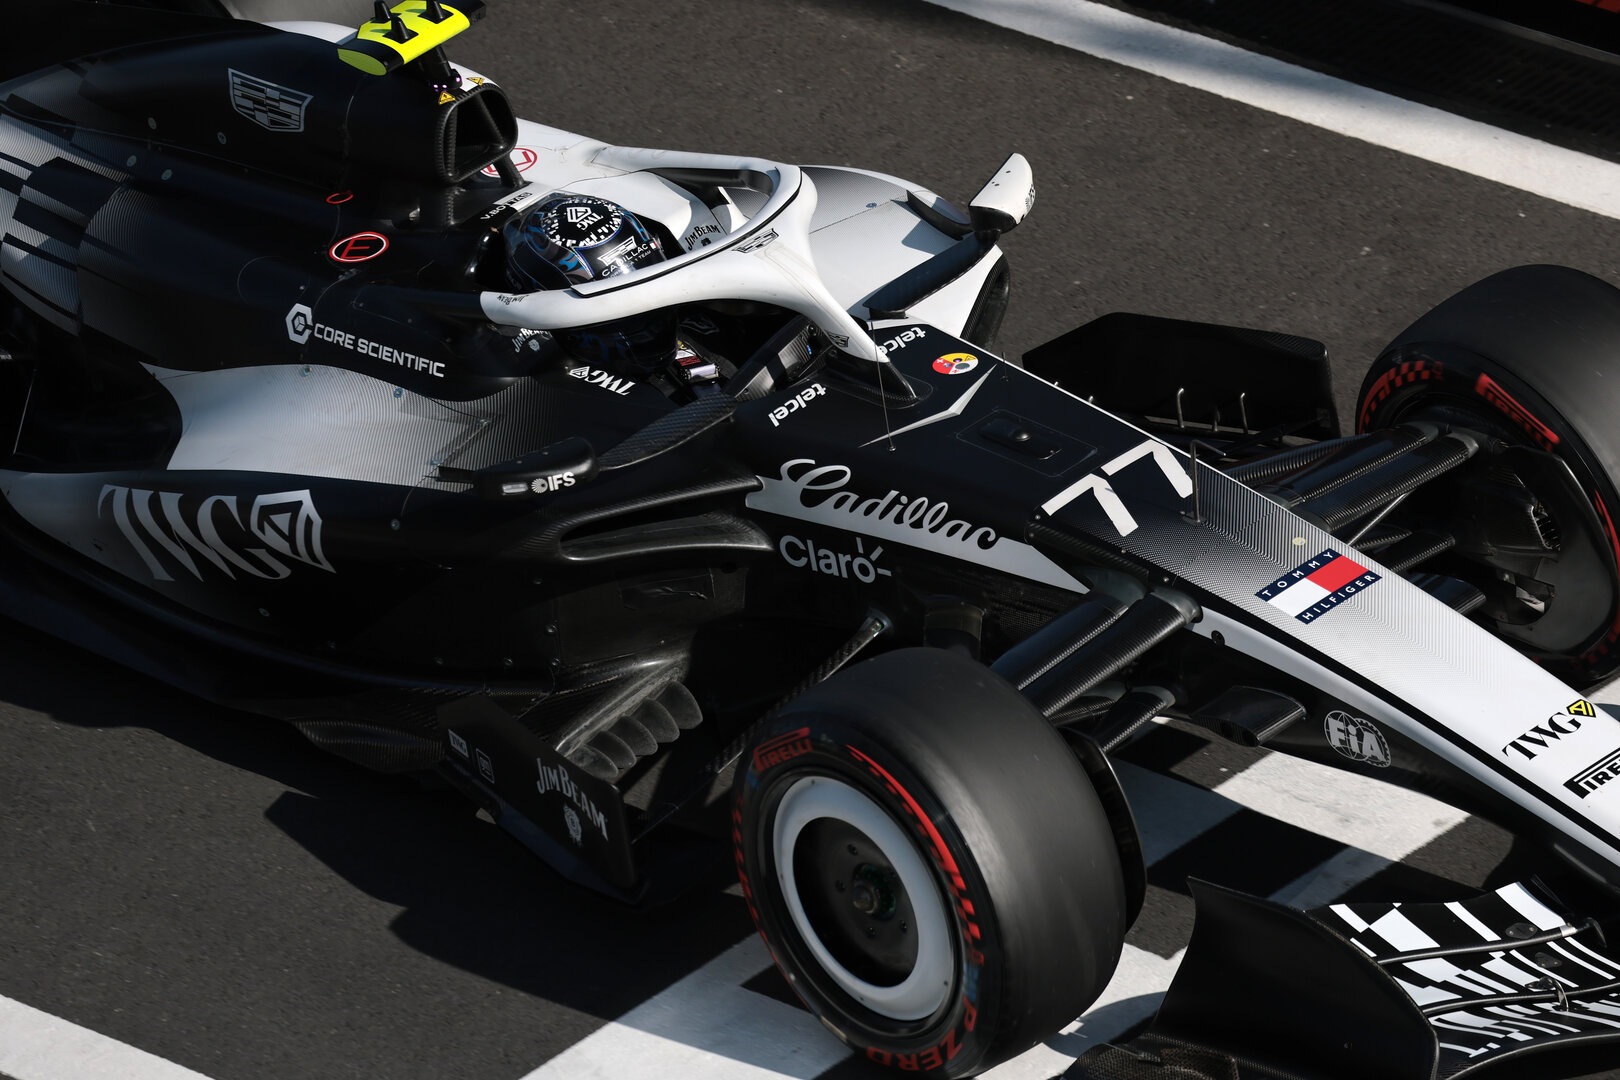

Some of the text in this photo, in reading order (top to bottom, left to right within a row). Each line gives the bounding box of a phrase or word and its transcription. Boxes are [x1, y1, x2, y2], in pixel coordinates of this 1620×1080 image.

[576, 212, 604, 230] TWG
[685, 224, 721, 251] JIM BEAM
[602, 243, 648, 277] CADILLAC
[314, 323, 446, 378] CORE SCIENTIFIC
[879, 327, 926, 355] telce
[584, 370, 636, 396] TWG
[768, 383, 827, 427] telcel
[547, 471, 577, 492] IFS
[780, 458, 1001, 550] Cadillac
[1041, 439, 1194, 537] 77
[97, 484, 292, 580] TWG
[1262, 551, 1334, 598] TOMMY
[1302, 574, 1376, 620] HILFIGER
[753, 727, 813, 772] PIRELLI
[1502, 712, 1582, 760] TWG
[1563, 747, 1620, 799] PIRE
[536, 757, 560, 794] JIM
[558, 764, 608, 841] BEAM
[866, 995, 978, 1071] P ZERO
